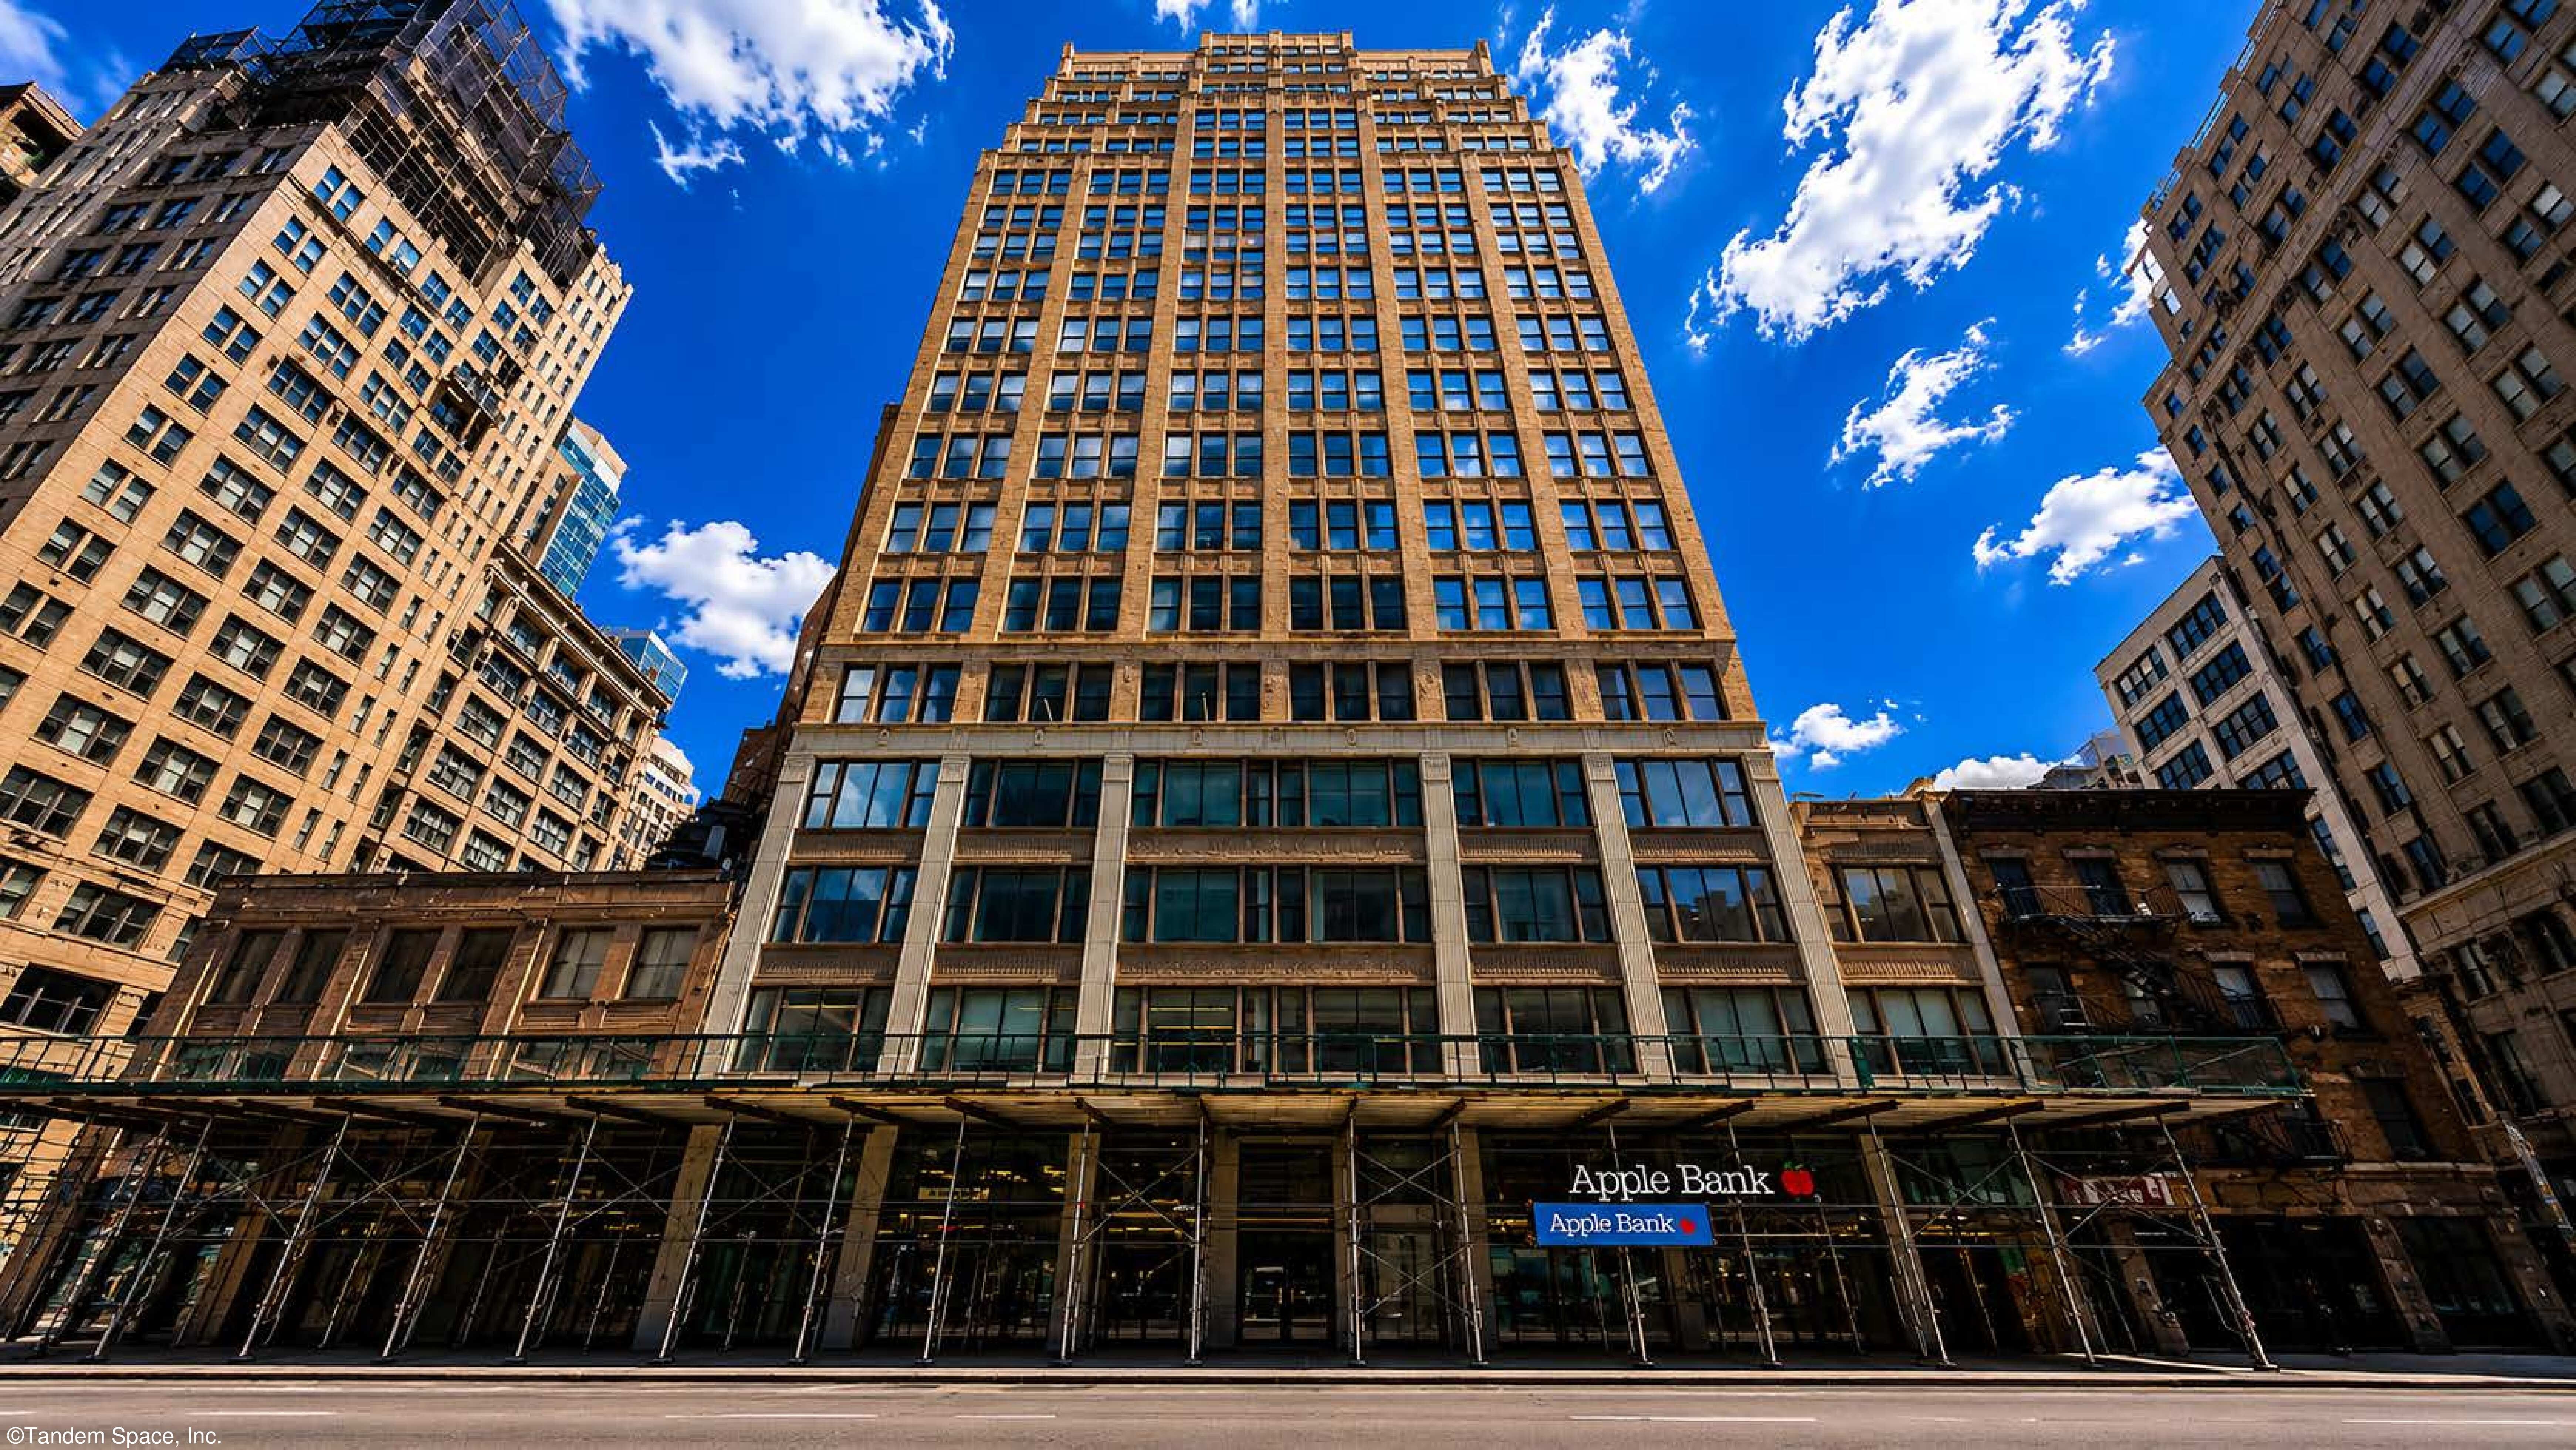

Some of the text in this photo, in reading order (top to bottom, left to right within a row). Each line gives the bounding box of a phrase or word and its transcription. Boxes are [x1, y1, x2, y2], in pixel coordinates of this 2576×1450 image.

[1569, 1164, 1775, 1202] Apple Bank
[1550, 1213, 1675, 1237] Apple Bank
